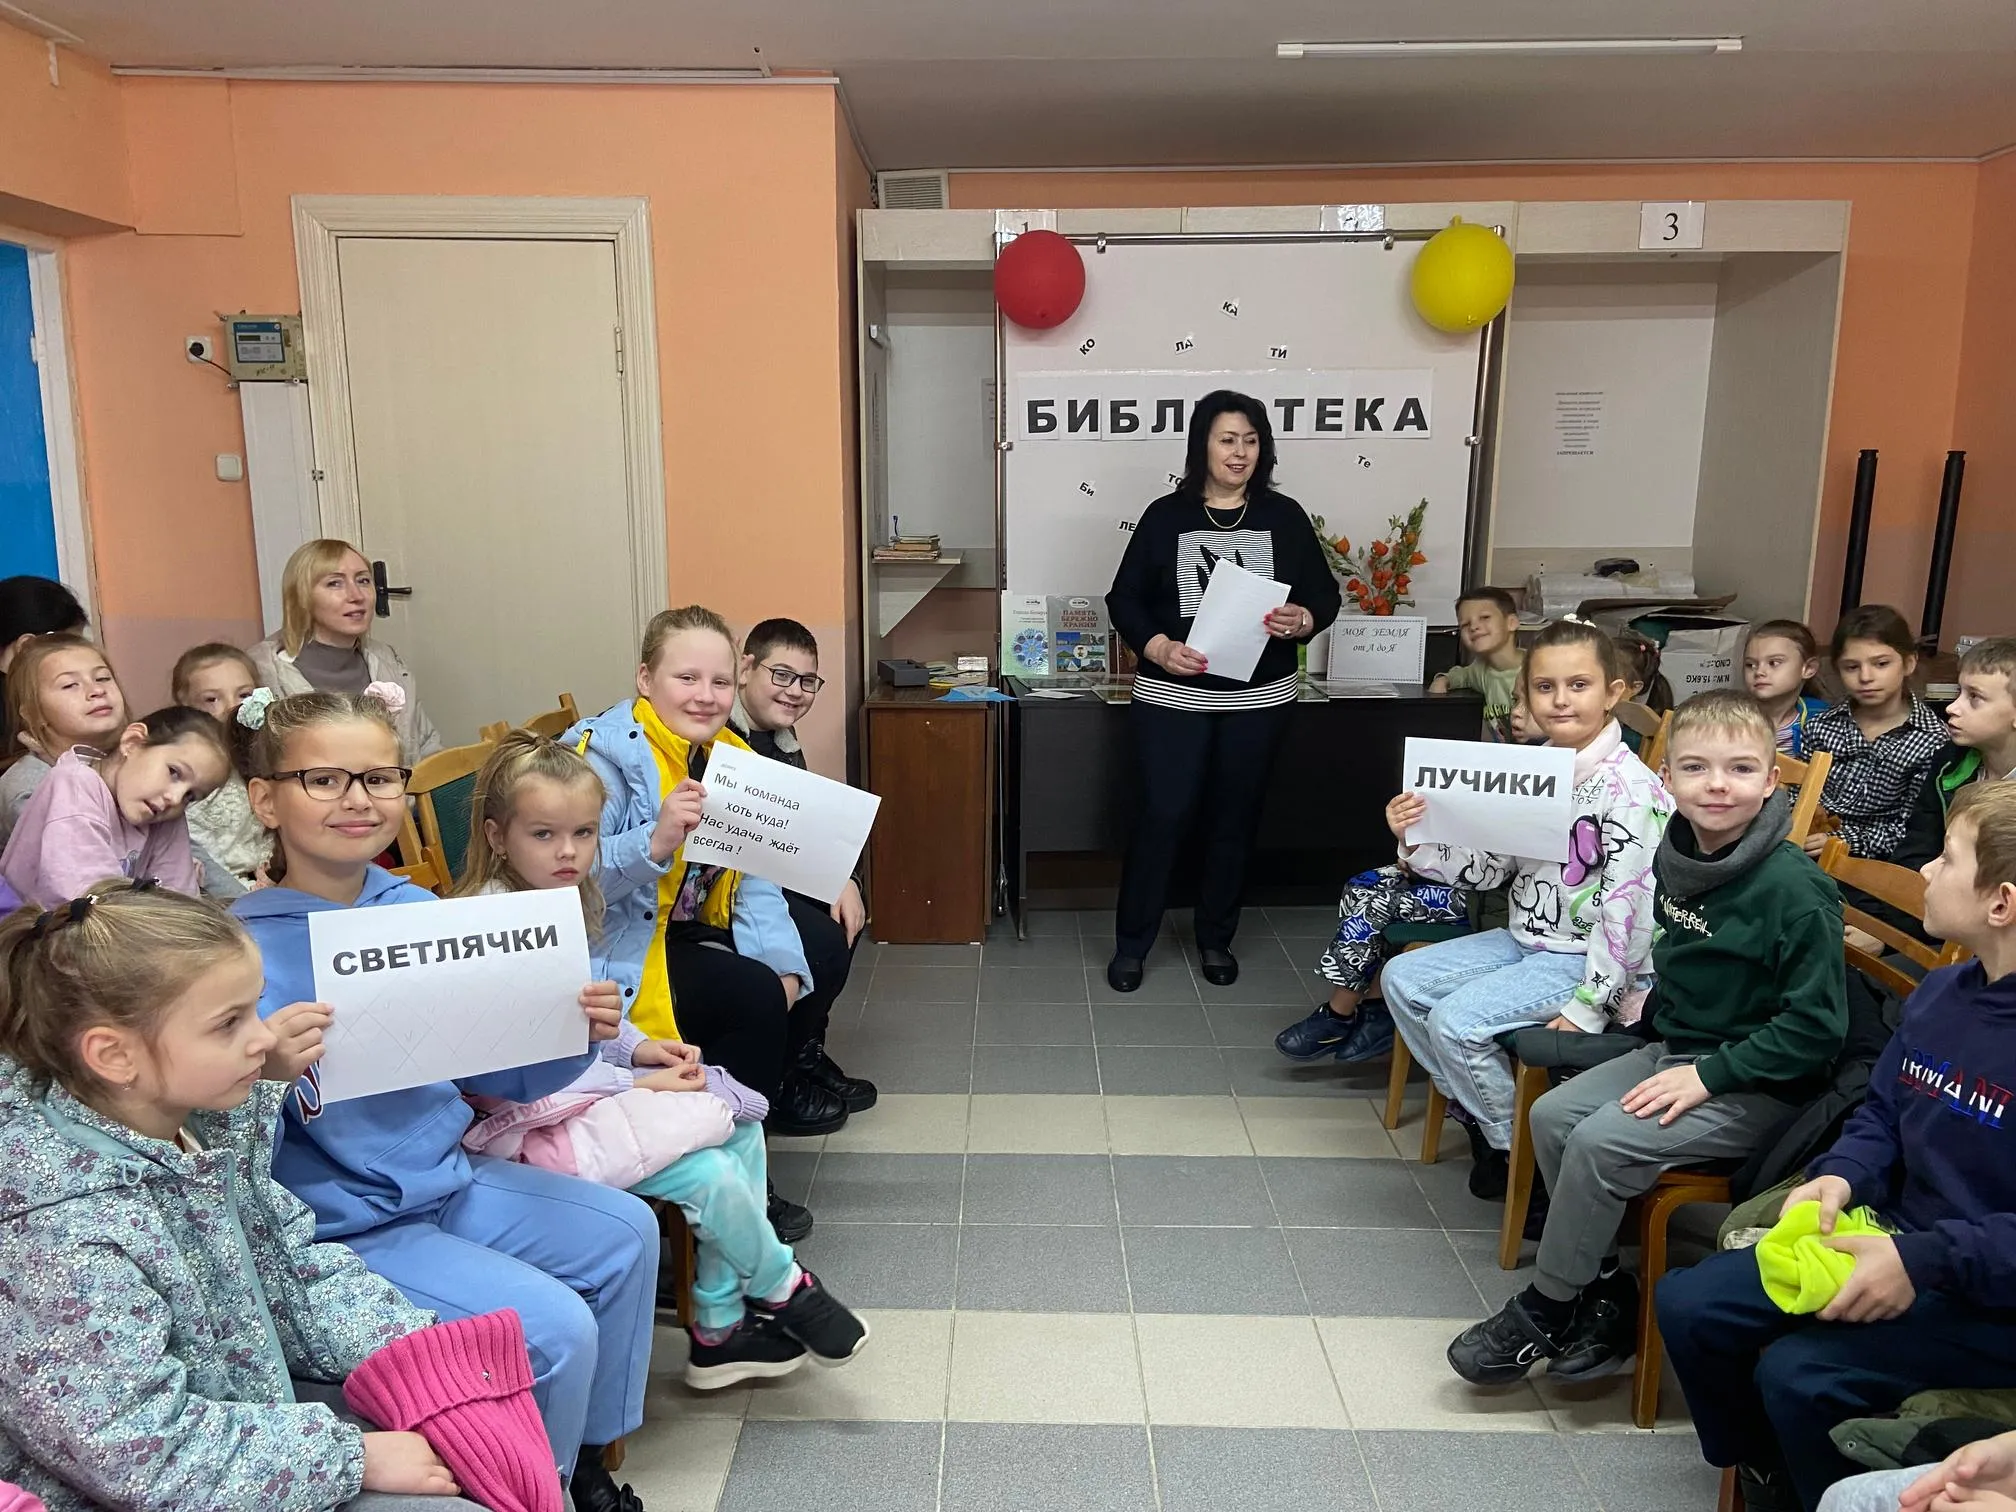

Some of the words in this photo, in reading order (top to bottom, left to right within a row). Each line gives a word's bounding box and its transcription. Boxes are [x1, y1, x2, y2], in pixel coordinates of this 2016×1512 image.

[1663, 213, 1678, 240] 3
[1222, 301, 1238, 316] КА
[1080, 339, 1095, 355] КО
[1175, 339, 1193, 352] ЛА
[1270, 347, 1287, 359] ТИ
[1027, 398, 1428, 434] БИБЛТЕКА
[1357, 455, 1371, 468] Те
[1079, 482, 1095, 497] Би
[1342, 627, 1367, 637] МОЯ
[1372, 627, 1411, 638] ЗЕМЛЯ
[714, 772, 737, 789] Мы
[744, 785, 800, 811] команда
[1415, 766, 1556, 798] ЛУЧИКИ
[724, 802, 752, 818] хоть
[755, 812, 789, 830] куда!
[693, 835, 733, 853] всегда
[700, 813, 724, 829] Нас
[725, 823, 763, 843] удача
[769, 838, 800, 855] ждёт
[332, 924, 559, 976] СВЕТЛЯЧКИ
[482, 1109, 516, 1136] JUST
